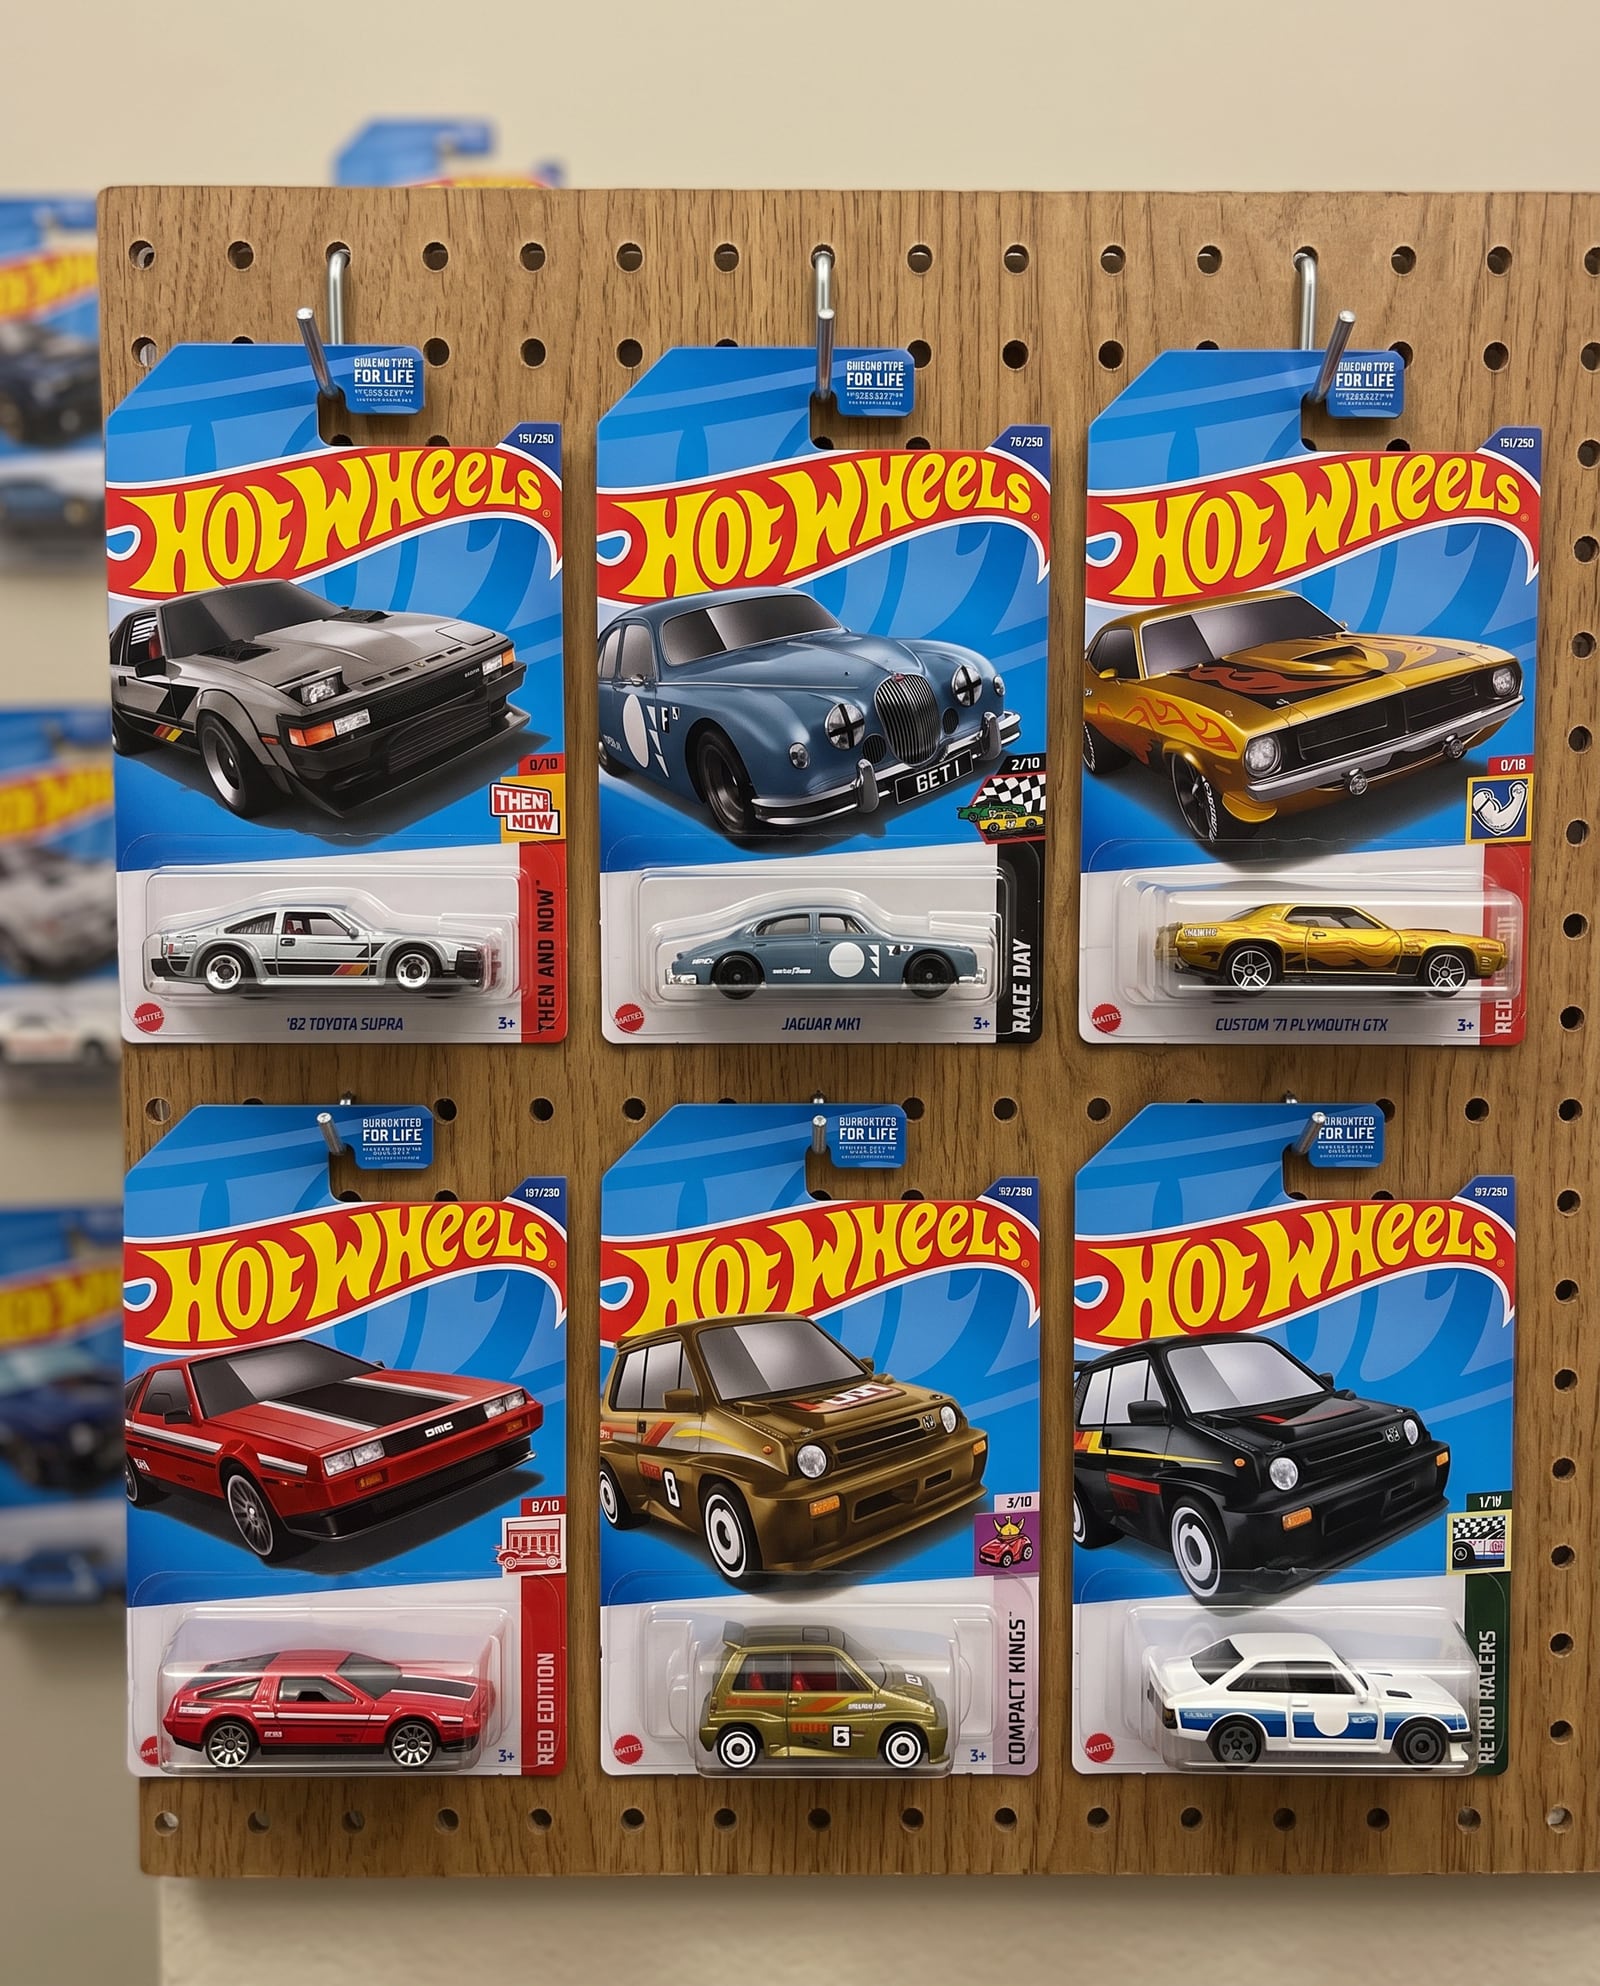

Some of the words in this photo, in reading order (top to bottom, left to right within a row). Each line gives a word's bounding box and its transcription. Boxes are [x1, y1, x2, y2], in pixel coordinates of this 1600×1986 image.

[391, 358, 414, 368] TYPE
[883, 361, 904, 371] TYPE
[354, 369, 381, 383] FOR
[384, 369, 415, 383] LIFE
[846, 372, 873, 386] FOR
[876, 372, 904, 387] LIFE
[1365, 373, 1395, 387] LIFE
[1010, 436, 1043, 447] 76/250
[1011, 757, 1040, 771] 2/10
[512, 814, 554, 831] NOW
[537, 939, 555, 978] AND
[1012, 938, 1031, 978] DAY
[537, 985, 555, 1030] THEN
[1012, 983, 1031, 1033] RACE
[498, 1016, 516, 1030] 3+
[973, 1016, 990, 1030] 3+
[1494, 999, 1513, 1034] RED
[286, 1017, 306, 1031] '82
[309, 1017, 358, 1031] TOYOTA
[360, 1017, 404, 1031] SUPRA
[781, 1017, 832, 1031] JAGUAR
[834, 1017, 861, 1031] MK1
[1215, 1018, 1269, 1031] CUSTOM
[1289, 1018, 1361, 1032] PLYMOUTH
[1362, 1018, 1389, 1032] GTX
[1456, 1018, 1475, 1032] 3+
[363, 1129, 389, 1142] FOR
[392, 1128, 422, 1142] LIFE
[868, 1127, 897, 1141] LIFE
[1318, 1127, 1343, 1140] FOR
[1346, 1127, 1375, 1140] LIFE
[532, 1500, 560, 1513] 8/10
[1006, 1496, 1032, 1509] 3/10
[1008, 1619, 1026, 1673] KINGS
[536, 1653, 555, 1723] EDITION
[1008, 1678, 1026, 1765] COMPACT
[1478, 1705, 1495, 1764] RETRO
[536, 1729, 555, 1765] RED
[498, 1749, 515, 1763] 3+
[970, 1749, 987, 1762] 3+
